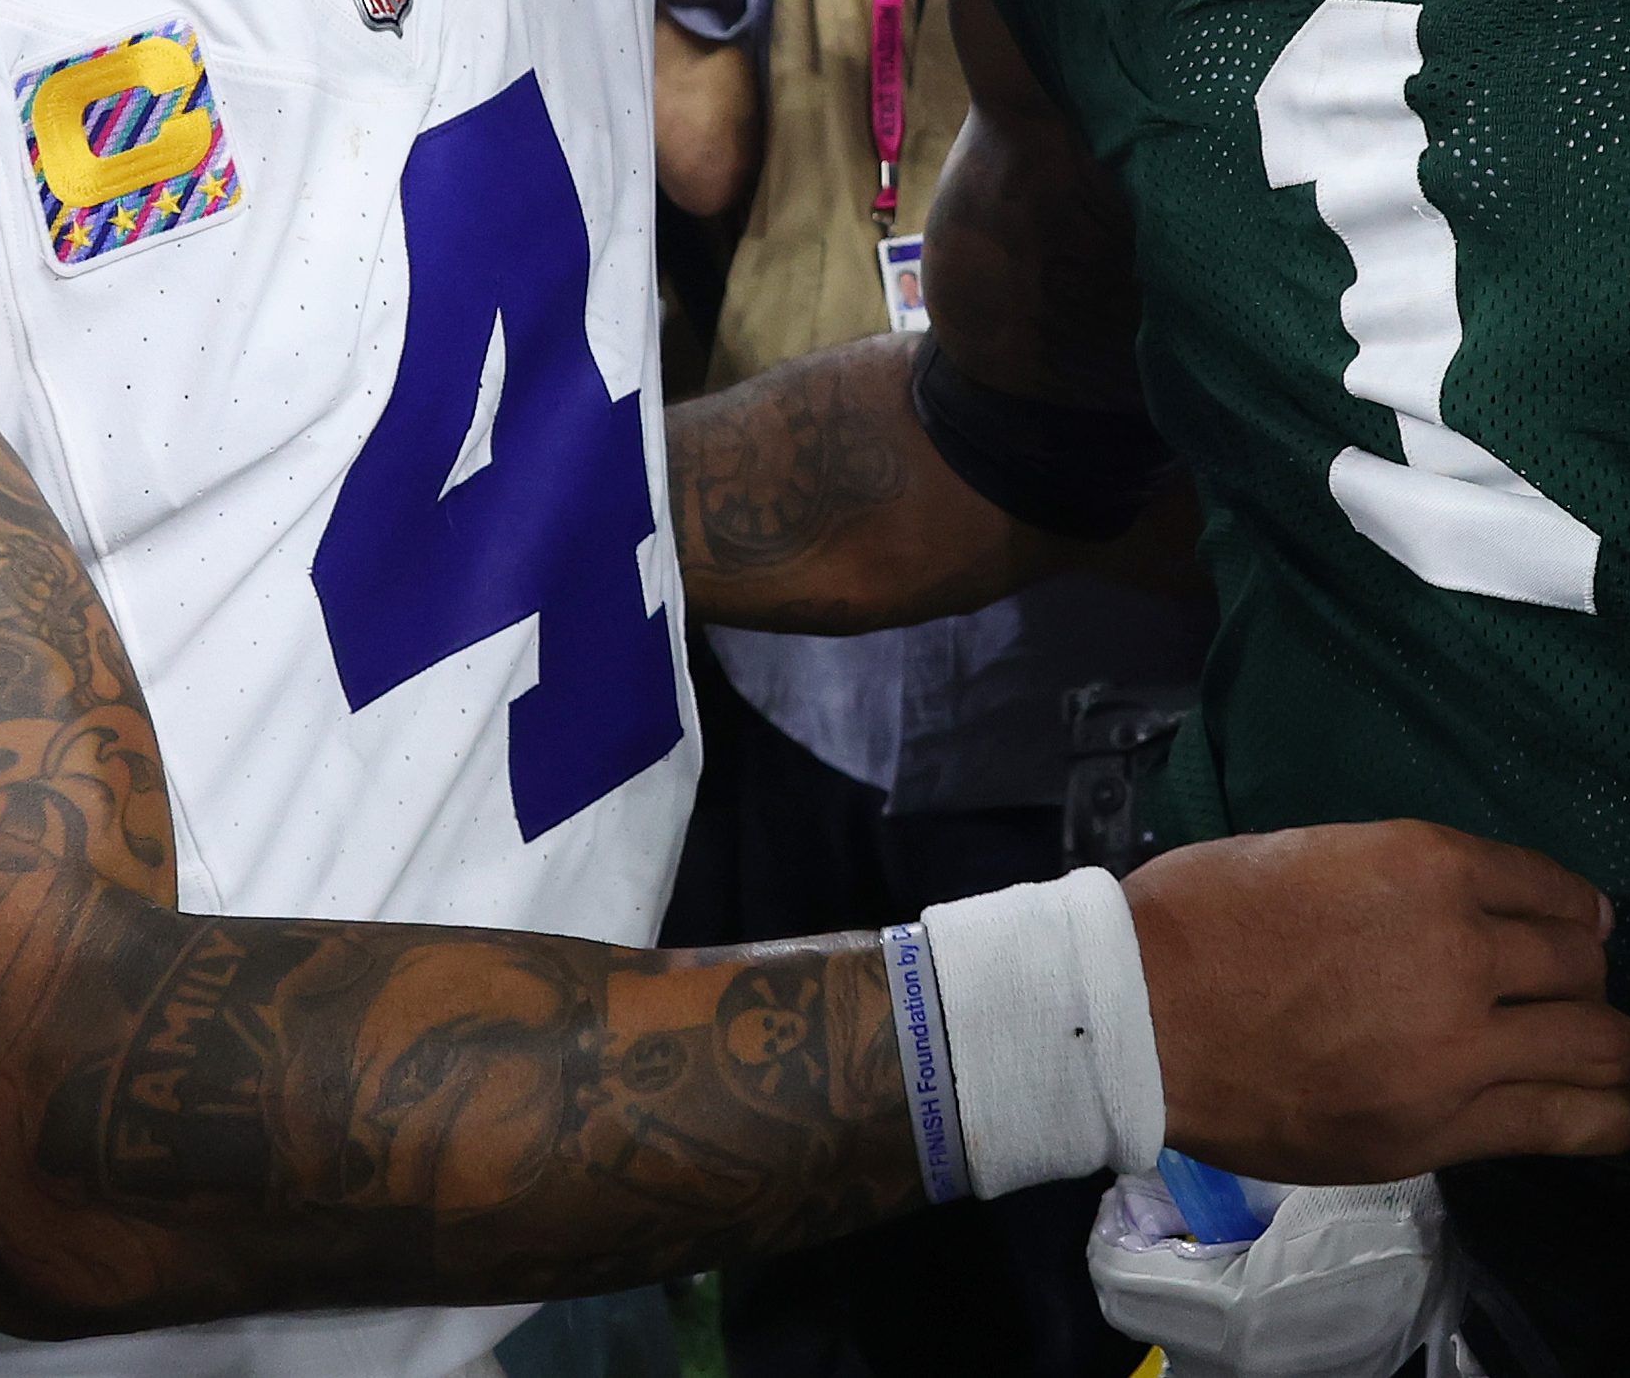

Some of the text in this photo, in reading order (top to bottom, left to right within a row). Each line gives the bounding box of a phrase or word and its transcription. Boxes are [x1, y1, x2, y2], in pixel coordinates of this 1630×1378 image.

[31, 36, 213, 209] C
[309, 67, 684, 845] 4
[896, 943, 920, 969] by
[112, 927, 249, 1162] FAMILY
[902, 969, 938, 1094] Foundation
[921, 1097, 952, 1168] FINISH
